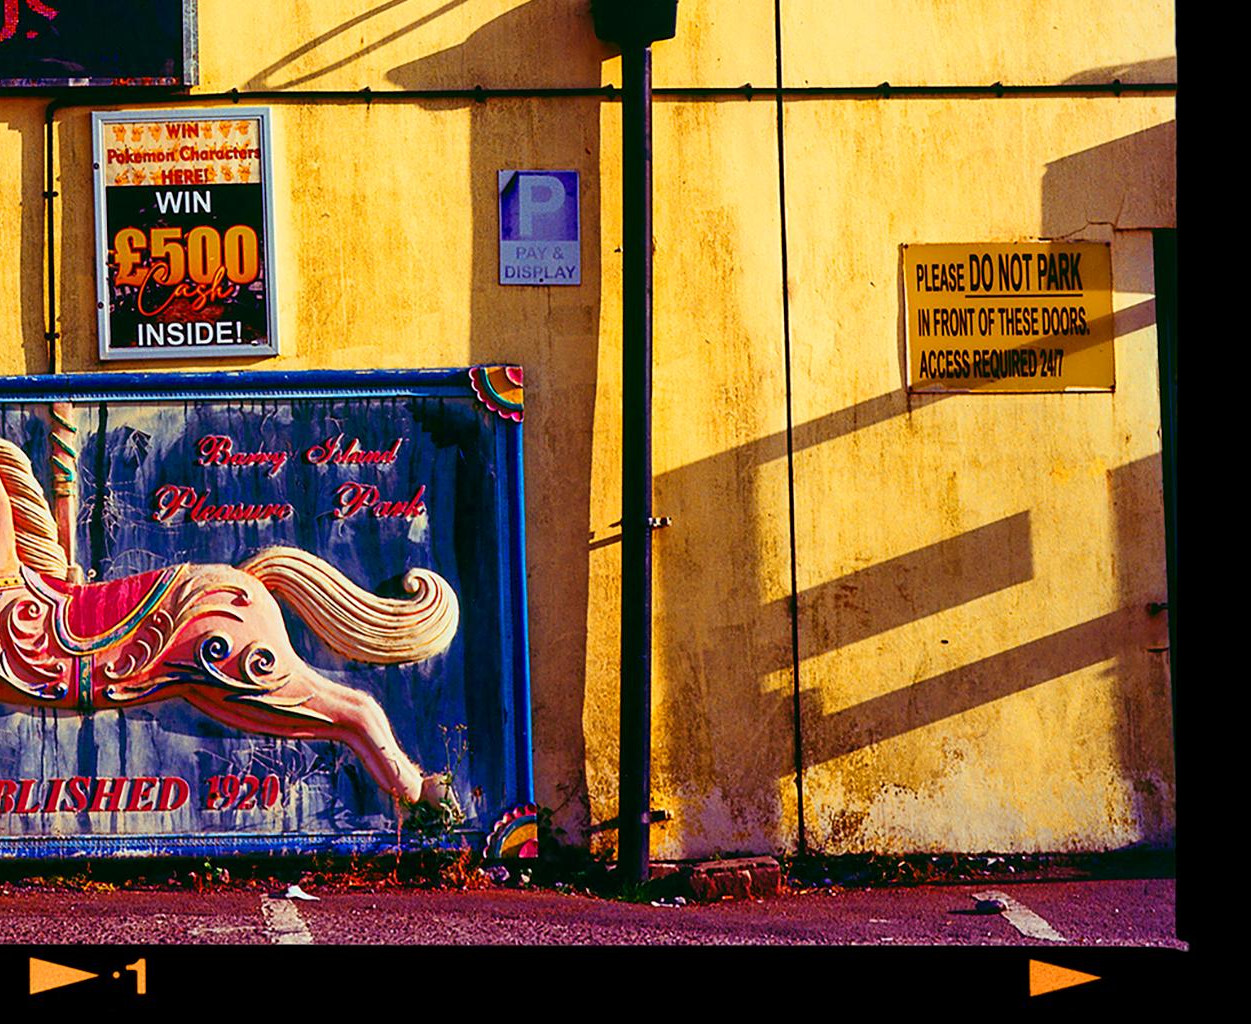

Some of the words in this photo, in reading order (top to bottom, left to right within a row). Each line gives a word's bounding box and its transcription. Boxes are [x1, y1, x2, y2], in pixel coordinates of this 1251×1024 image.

[165, 124, 200, 139] WIN
[107, 148, 176, 165] Pokemon
[179, 145, 261, 162] Characters
[161, 169, 210, 185] HERE!
[155, 191, 212, 215] WIN
[519, 175, 566, 237] P
[113, 225, 260, 287] £500
[516, 247, 547, 260] PAY
[553, 246, 564, 260] &
[505, 265, 576, 279] DISPLAY
[916, 263, 965, 292] PLEASE
[969, 254, 994, 292] DO
[998, 253, 1033, 291] NOT
[1037, 252, 1084, 291] PARK
[137, 262, 234, 316] Cash
[137, 321, 242, 346] INSIDE!
[918, 309, 930, 336] IN
[934, 308, 975, 336] FRONT
[978, 308, 995, 336] OF
[998, 307, 1040, 335] THESE
[1042, 307, 1090, 335] DOORS.
[919, 350, 970, 379] ACCESS
[973, 349, 1038, 379] REQUIRED
[1039, 348, 1064, 377] 24/7
[198, 435, 288, 478] Barry
[306, 434, 403, 464] Island
[152, 483, 294, 522] Pleasure
[334, 482, 426, 518] Park
[204, 774, 281, 811] 1920
